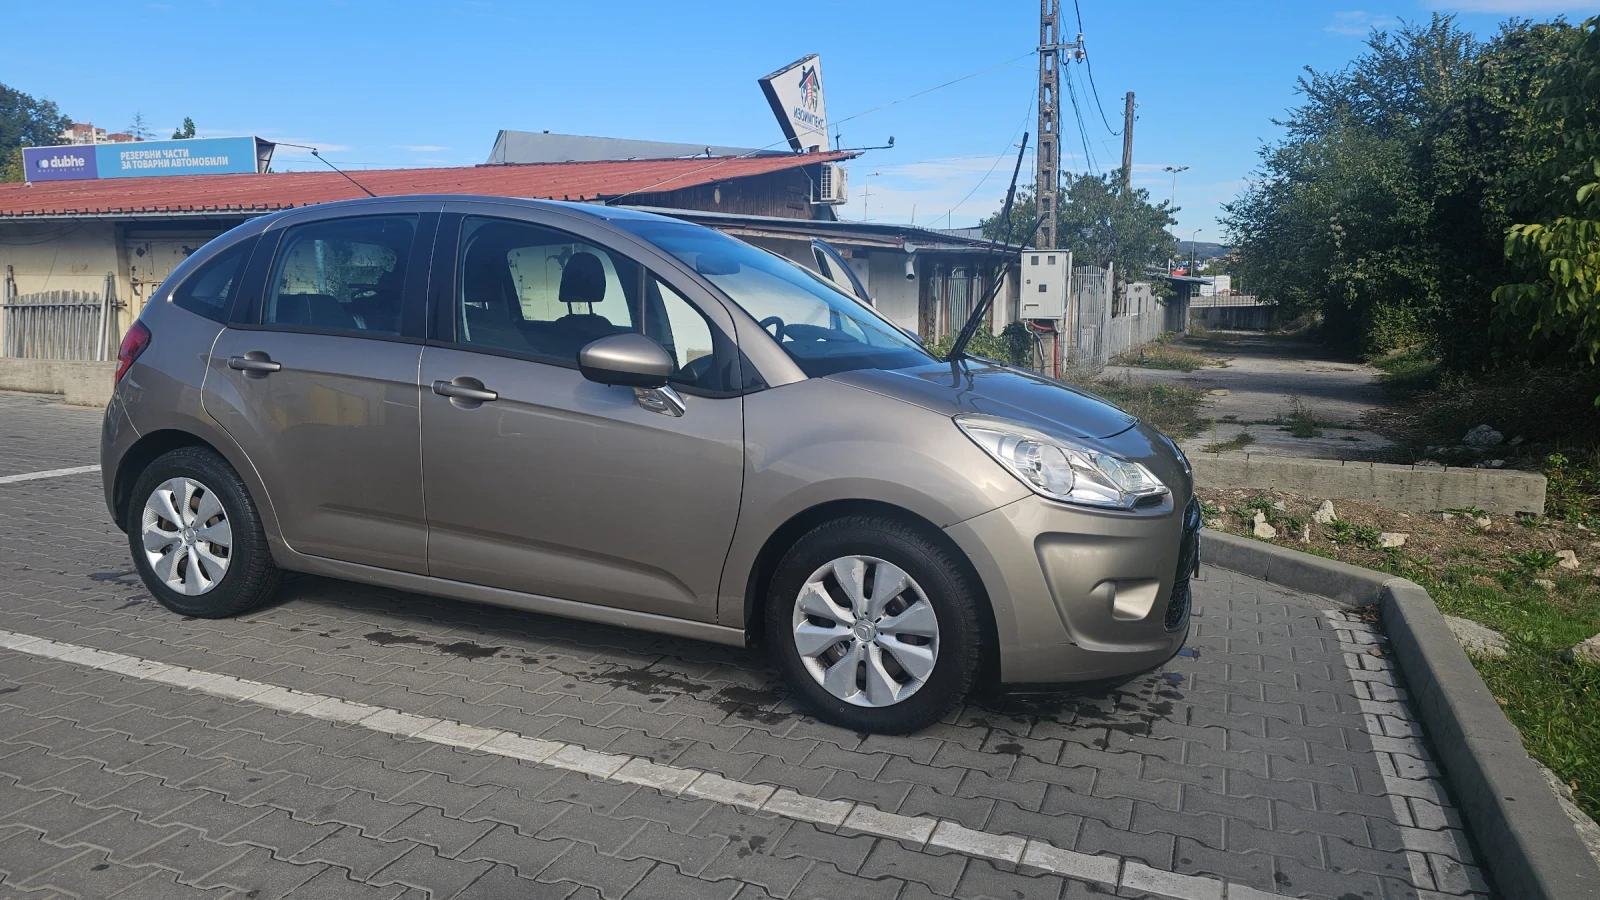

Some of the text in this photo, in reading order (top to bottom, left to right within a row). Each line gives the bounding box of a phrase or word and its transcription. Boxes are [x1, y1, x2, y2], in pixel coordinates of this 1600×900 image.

[120, 149, 189, 160] РЕЗЕРВНИ ЧАСТИ
[50, 155, 85, 167] dubhe
[121, 156, 228, 169] ЗА ТОВАРНИ АВТОМОБИЛИ
